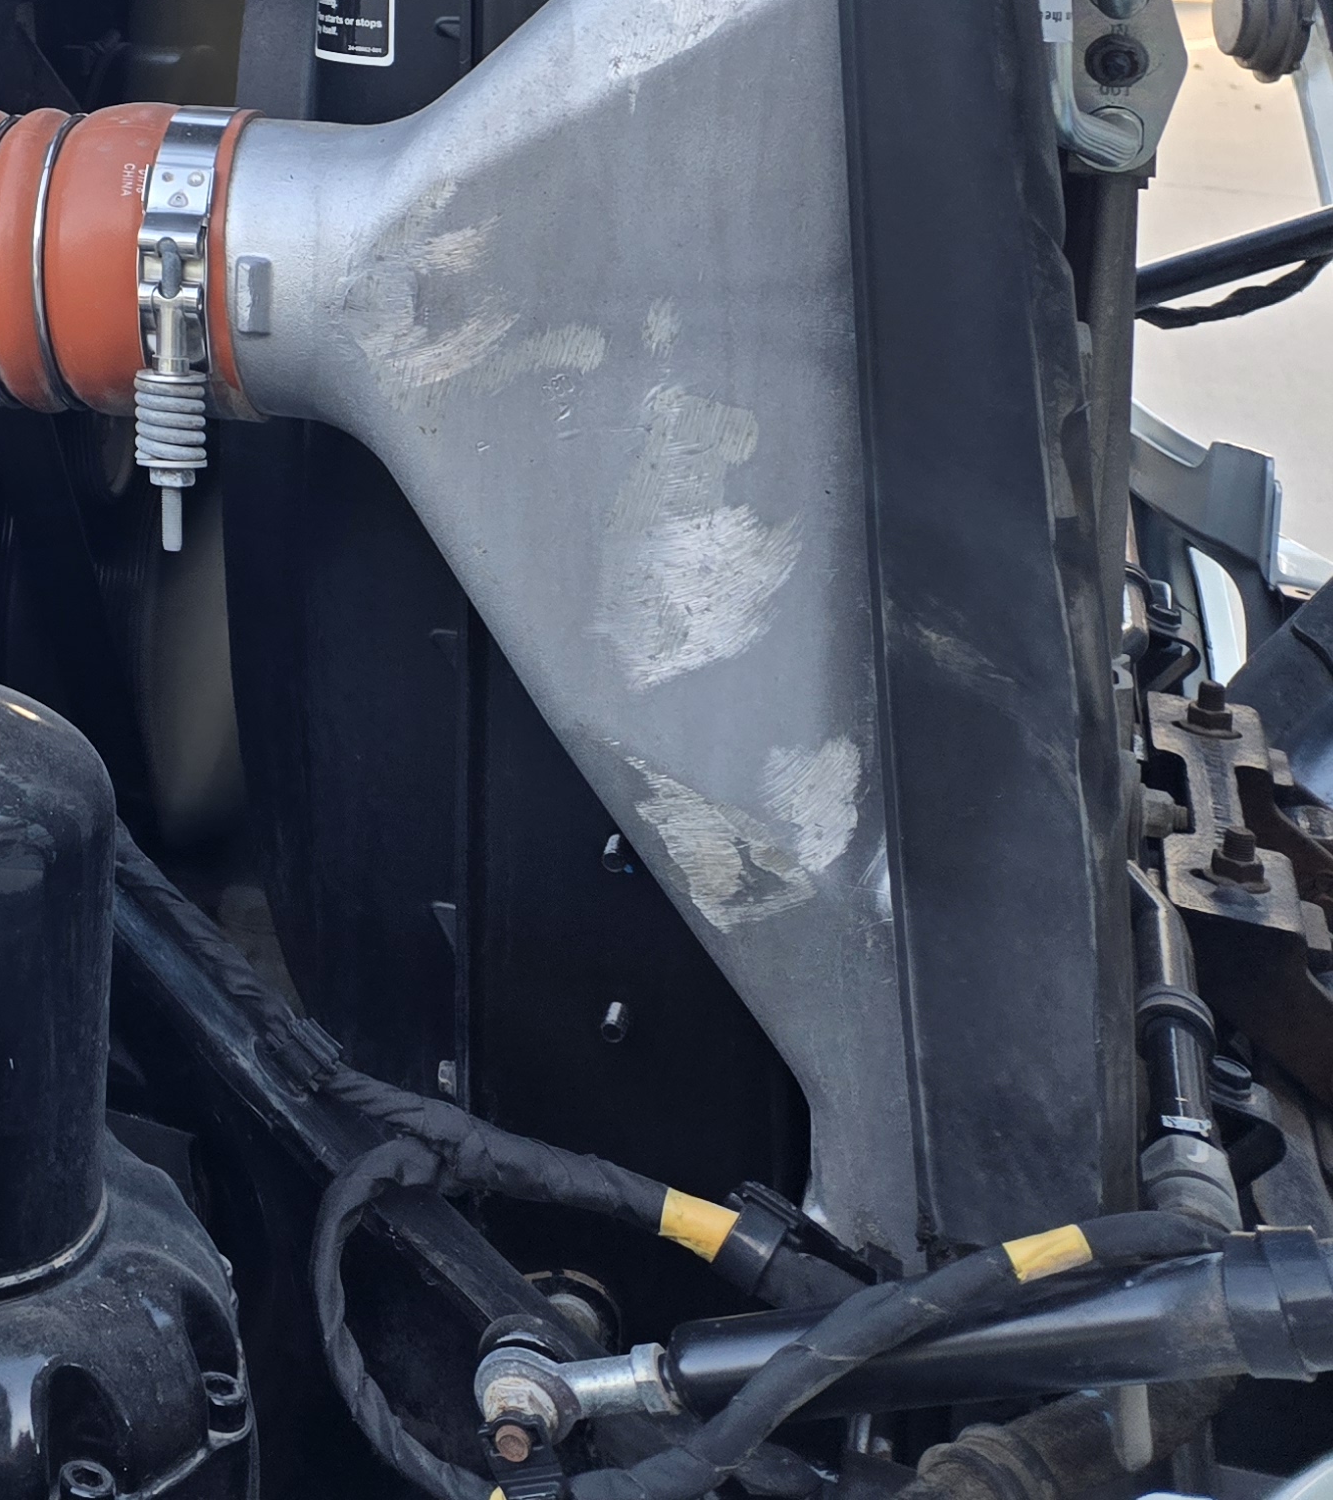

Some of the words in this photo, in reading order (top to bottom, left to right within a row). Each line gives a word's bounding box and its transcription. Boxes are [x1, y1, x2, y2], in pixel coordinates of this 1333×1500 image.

[325, 15, 344, 25] starts
[344, 17, 354, 26] or
[355, 18, 383, 29] stops
[120, 163, 136, 197] CHINA
